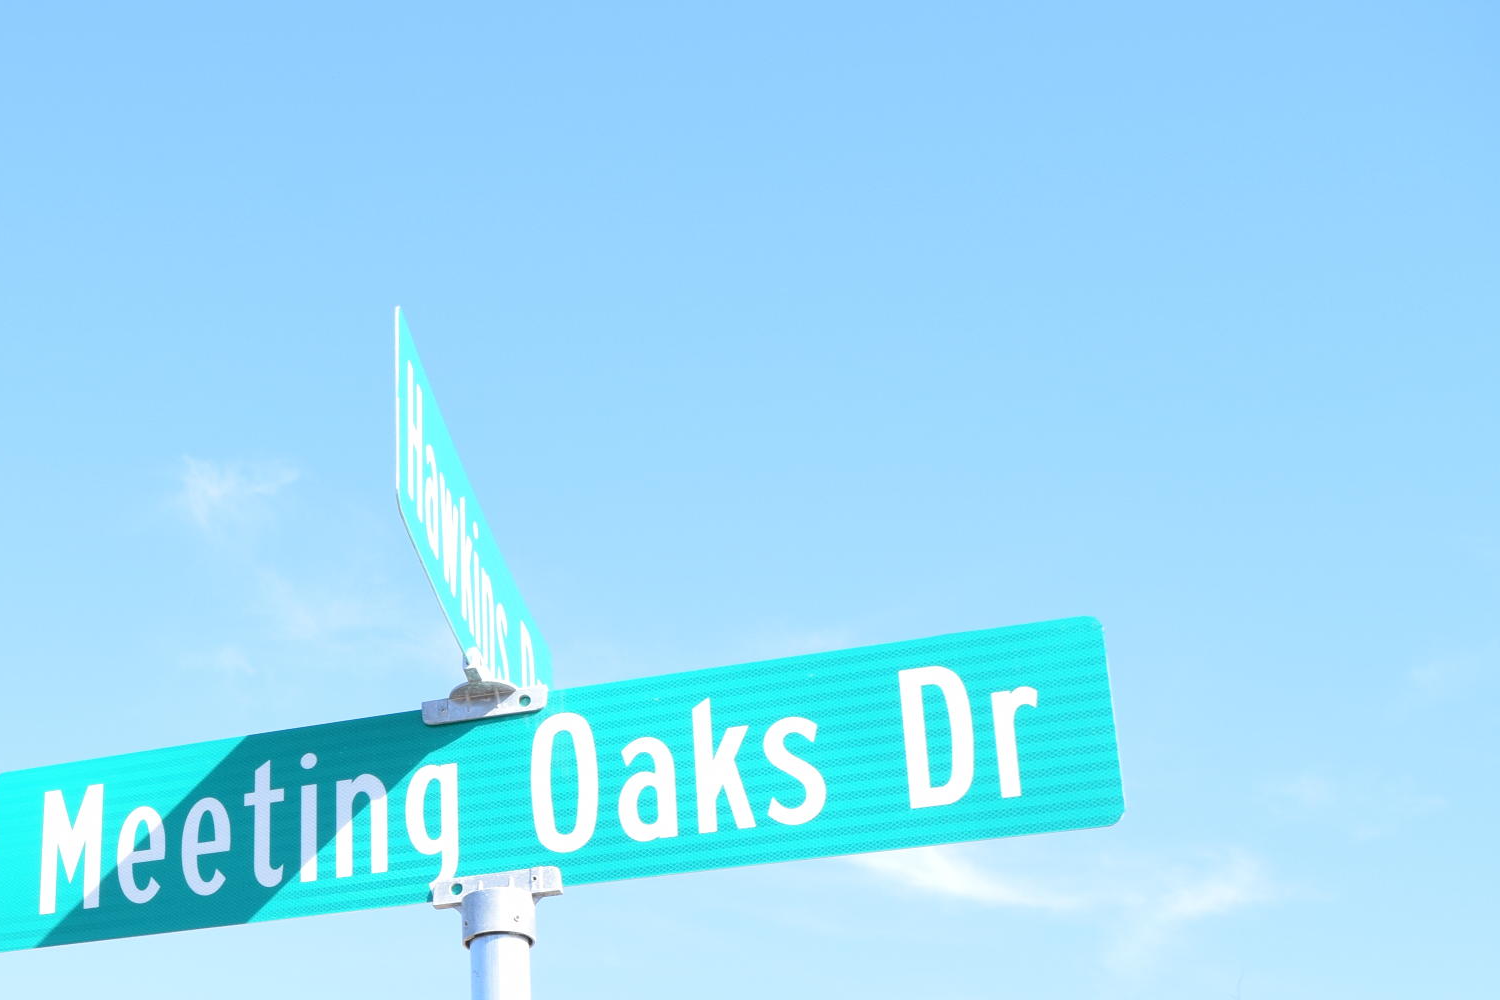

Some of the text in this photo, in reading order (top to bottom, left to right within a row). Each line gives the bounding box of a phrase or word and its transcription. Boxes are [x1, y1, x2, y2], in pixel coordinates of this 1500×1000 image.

[407, 359, 510, 682] Hawkins
[38, 665, 1038, 915] Meeting Oaks Dr
